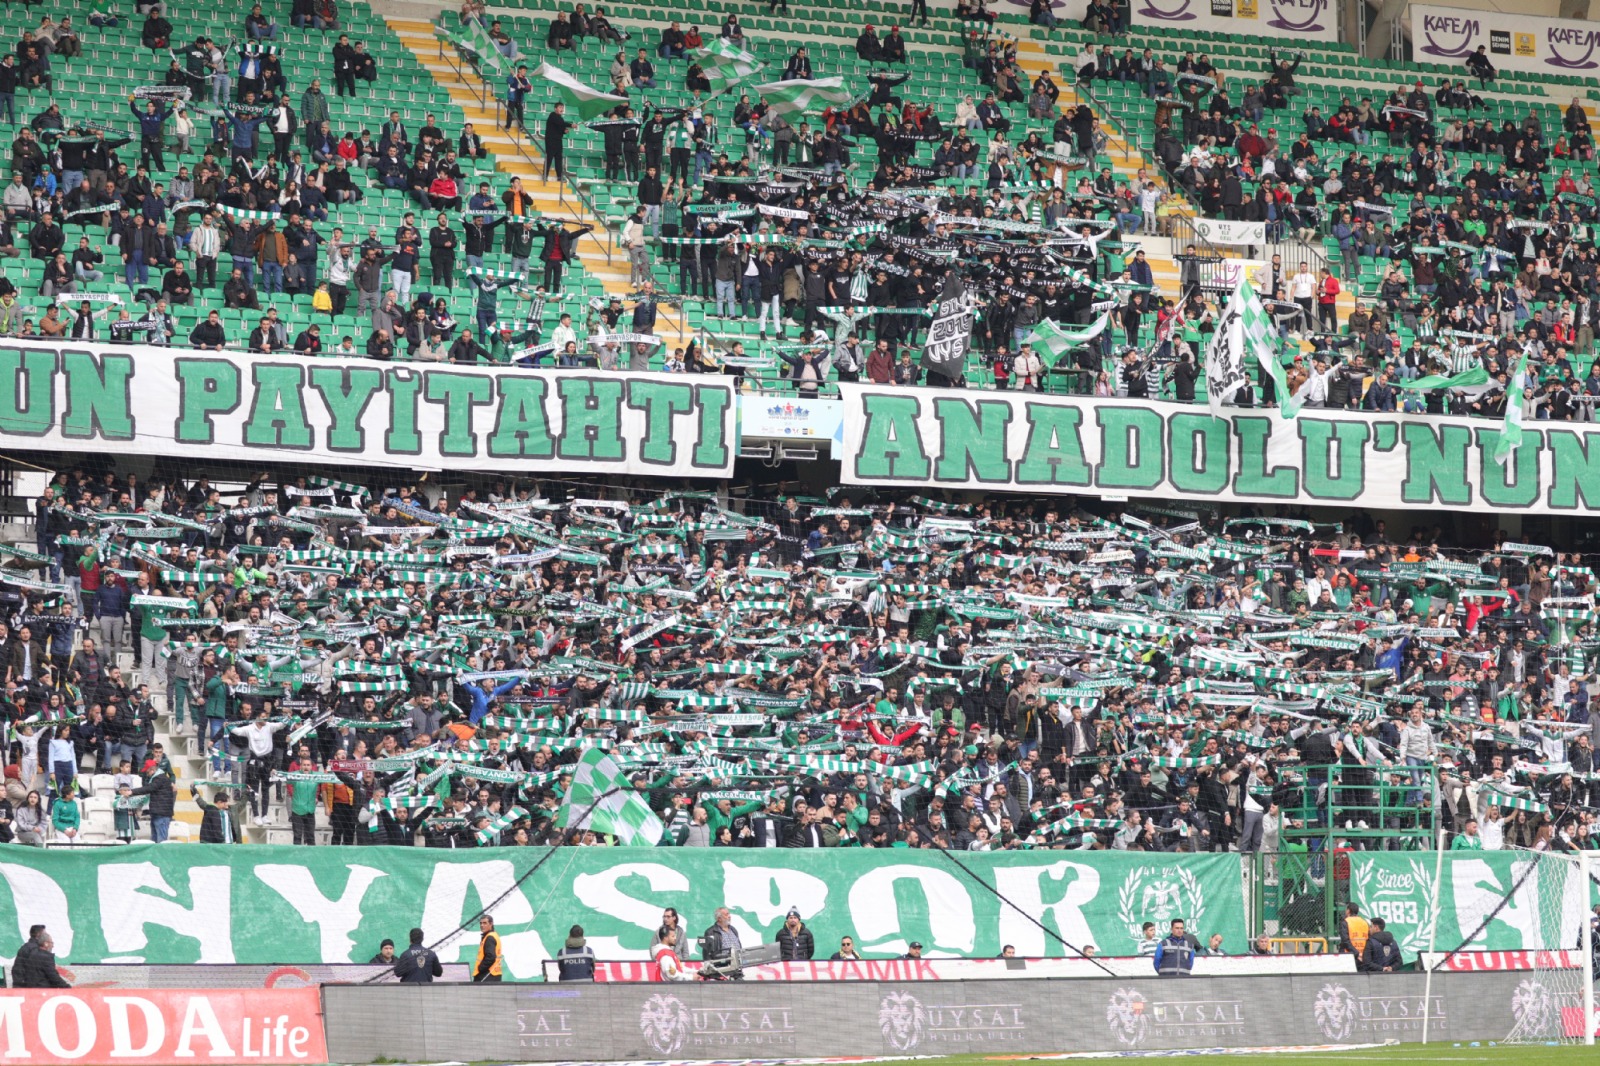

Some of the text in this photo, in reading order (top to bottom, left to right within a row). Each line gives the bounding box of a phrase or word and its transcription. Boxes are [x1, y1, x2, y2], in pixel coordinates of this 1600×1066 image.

[1424, 15, 1480, 36] KAFEM
[761, 186, 786, 194] ultras
[827, 206, 850, 219] ultras
[873, 206, 898, 216] ultras
[893, 235, 916, 245] ultras
[904, 247, 931, 262] ultras
[1022, 262, 1048, 272] ultras
[1001, 285, 1026, 299] ultras
[965, 607, 1011, 618] KONYASPOR
[452, 626, 499, 638] KONYASPOR
[1375, 868, 1414, 892] Since
[1370, 901, 1417, 924] 1983
[1152, 1003, 1244, 1022] UYSAL
[1360, 998, 1446, 1017] UYSAL
[692, 1011, 795, 1030] UYSAL
[928, 1006, 1025, 1027] UYSAL
[242, 1014, 310, 1058] Life
